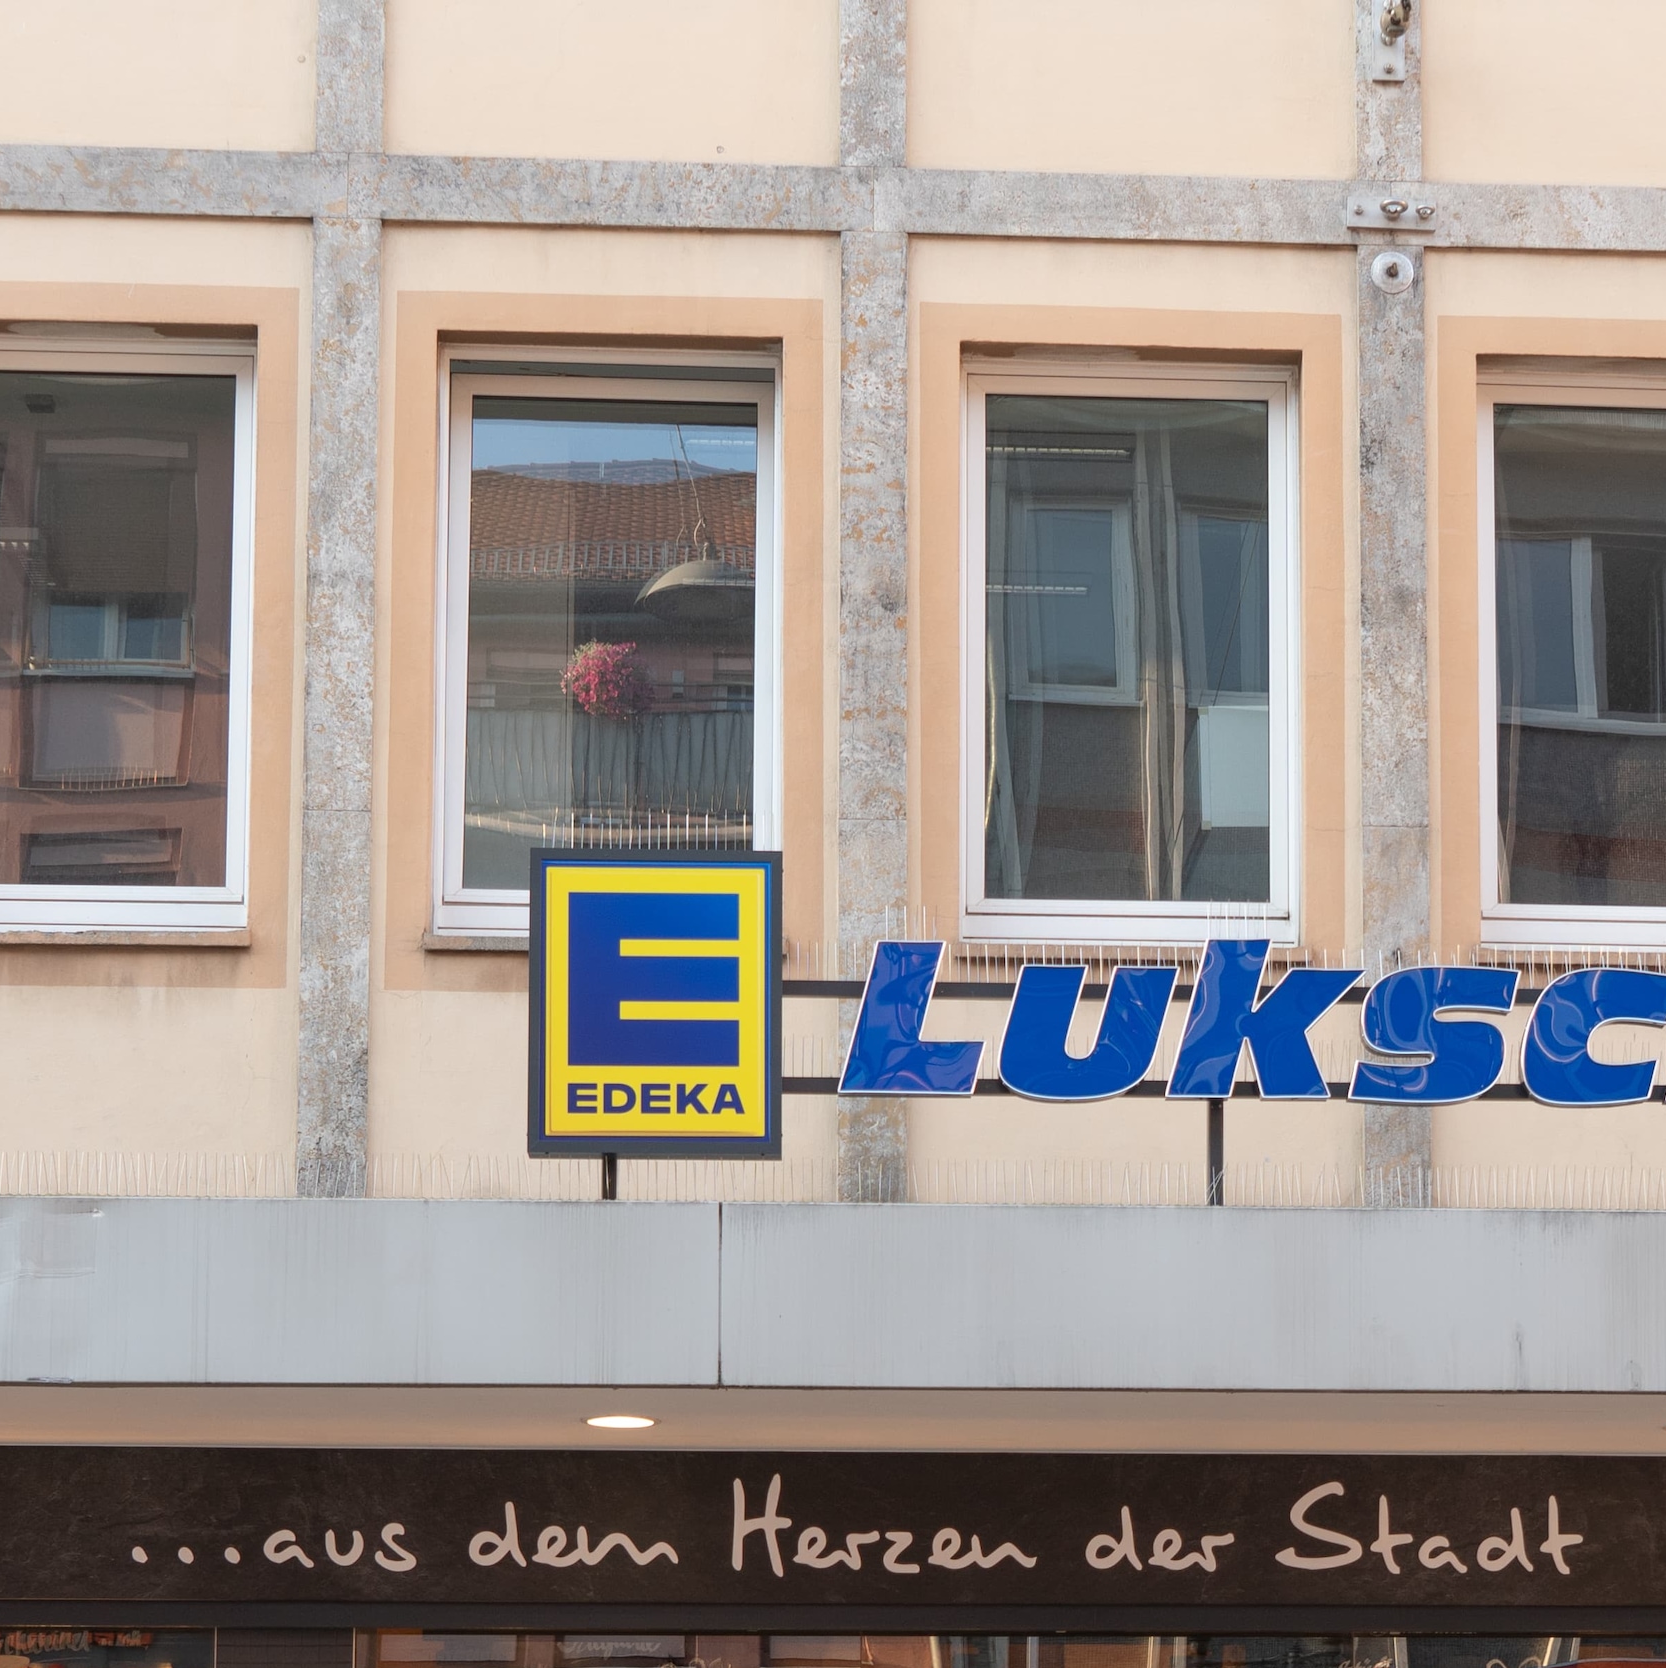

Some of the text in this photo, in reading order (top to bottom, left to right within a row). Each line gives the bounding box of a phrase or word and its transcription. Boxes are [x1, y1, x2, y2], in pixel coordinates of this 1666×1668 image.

[567, 1082, 746, 1116] EDEKA
[468, 1501, 679, 1567] dem
[732, 1473, 1037, 1578] Herzen
[1085, 1505, 1235, 1572] der
[1274, 1481, 1584, 1575] Stadt
